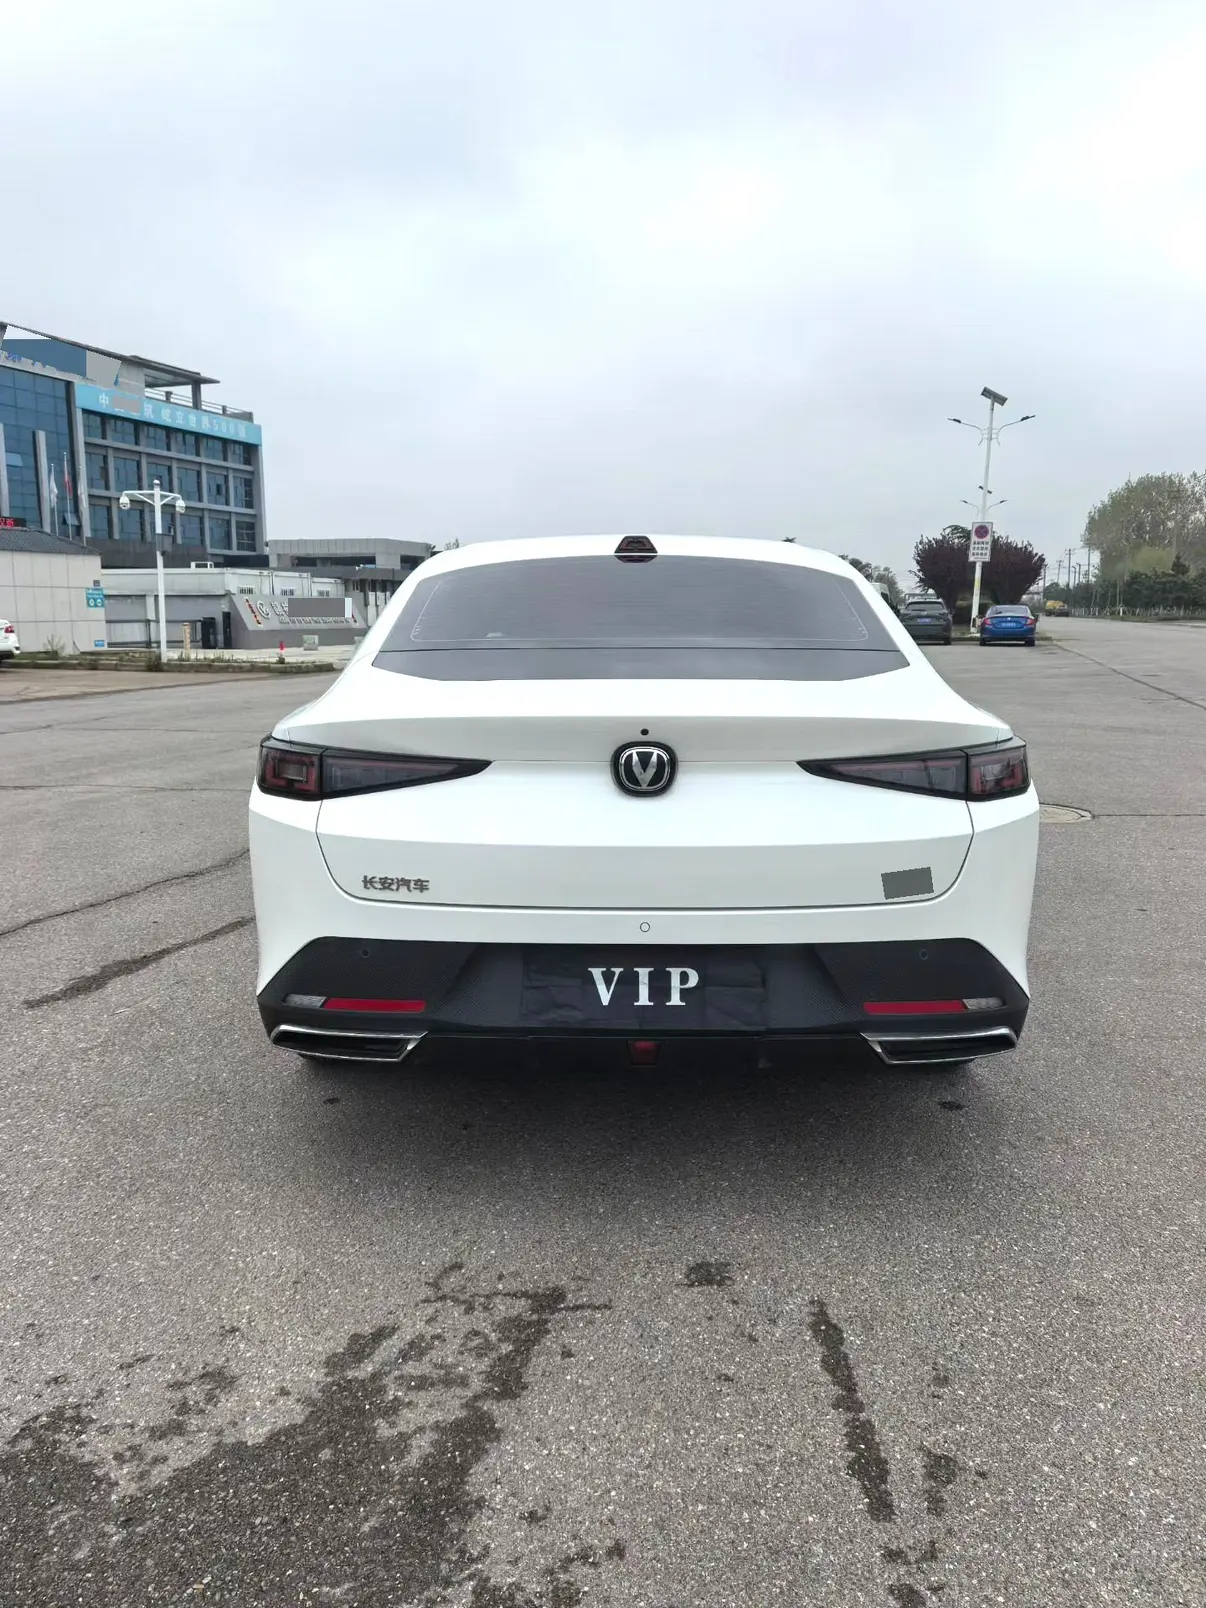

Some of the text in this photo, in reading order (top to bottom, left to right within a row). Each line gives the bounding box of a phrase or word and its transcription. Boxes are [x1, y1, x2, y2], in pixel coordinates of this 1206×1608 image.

[362, 874, 430, 893] 长安汽车
[587, 967, 700, 1006] VIP
